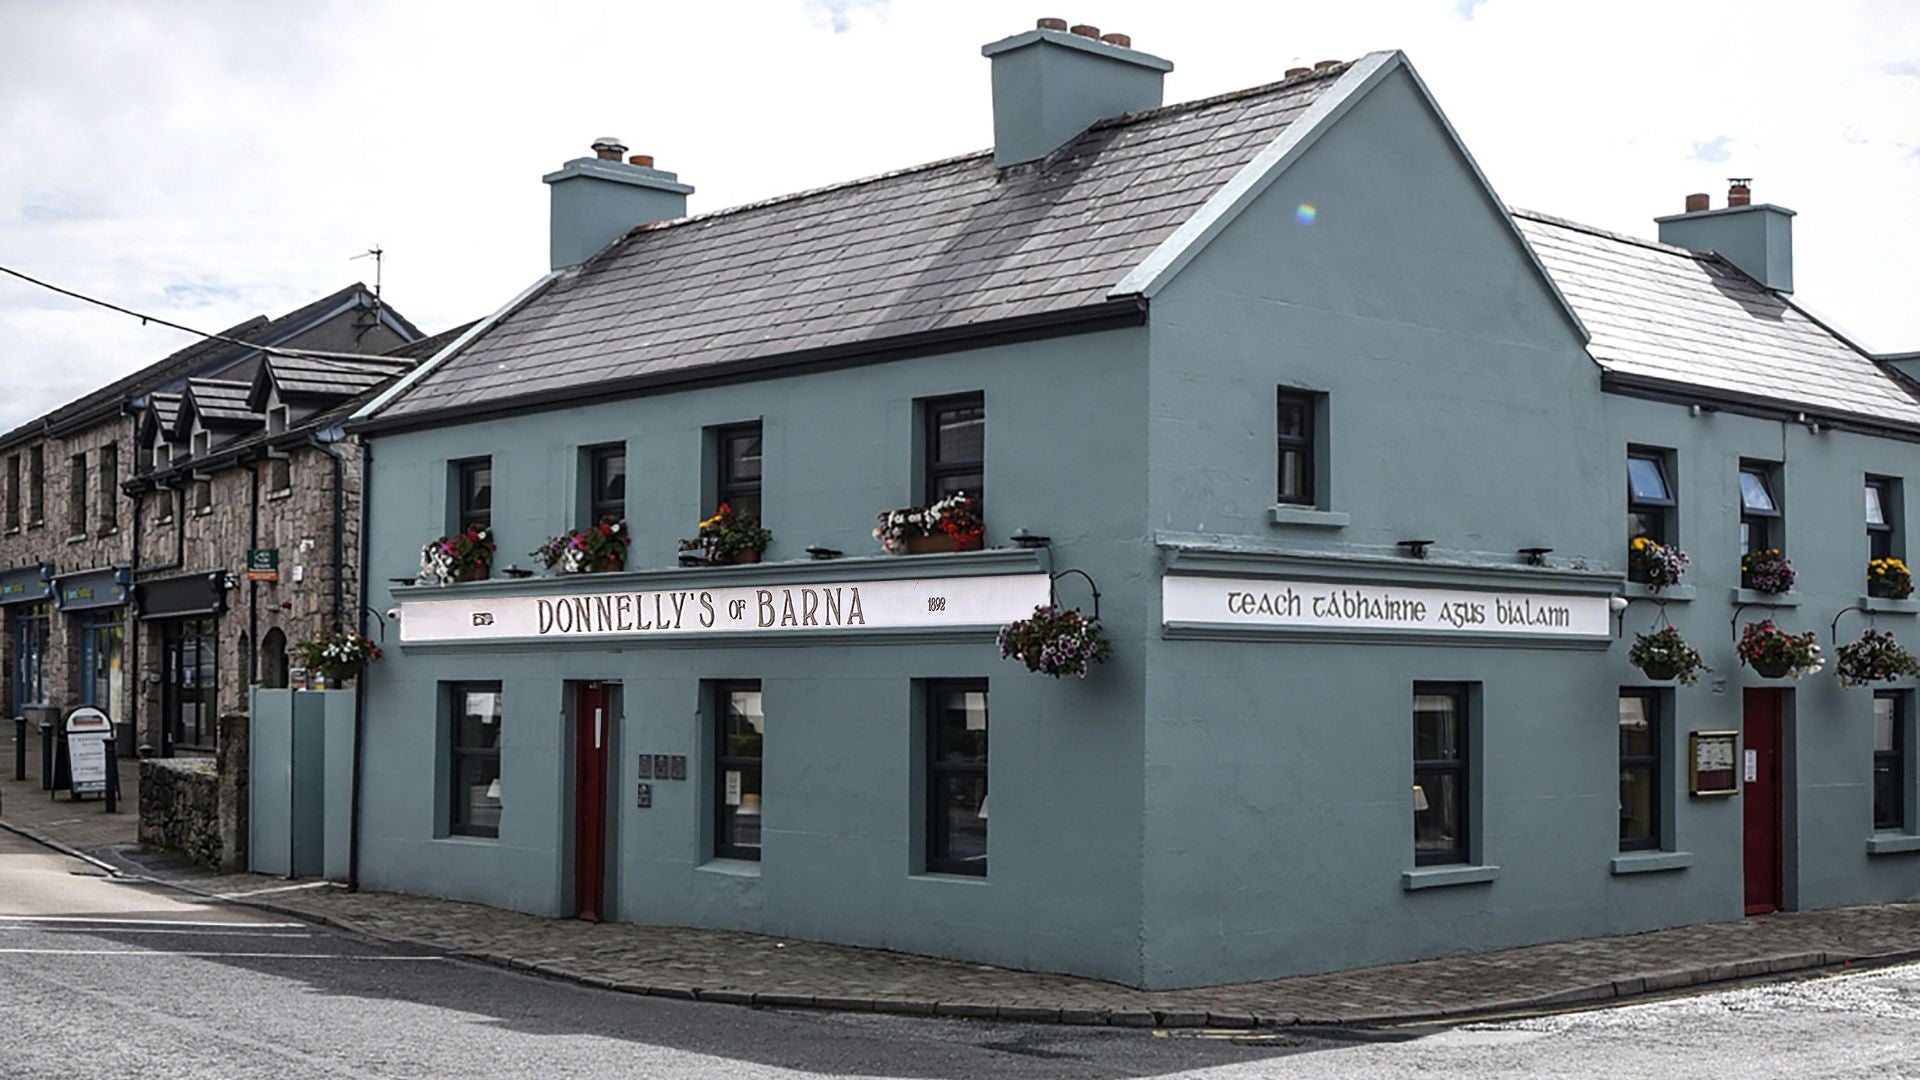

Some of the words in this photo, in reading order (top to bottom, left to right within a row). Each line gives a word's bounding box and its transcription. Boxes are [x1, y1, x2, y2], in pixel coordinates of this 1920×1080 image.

[537, 591, 715, 634] DONNELLY'S
[728, 599, 746, 620] OF
[756, 587, 865, 628] BARNA
[927, 596, 946, 612] 1892
